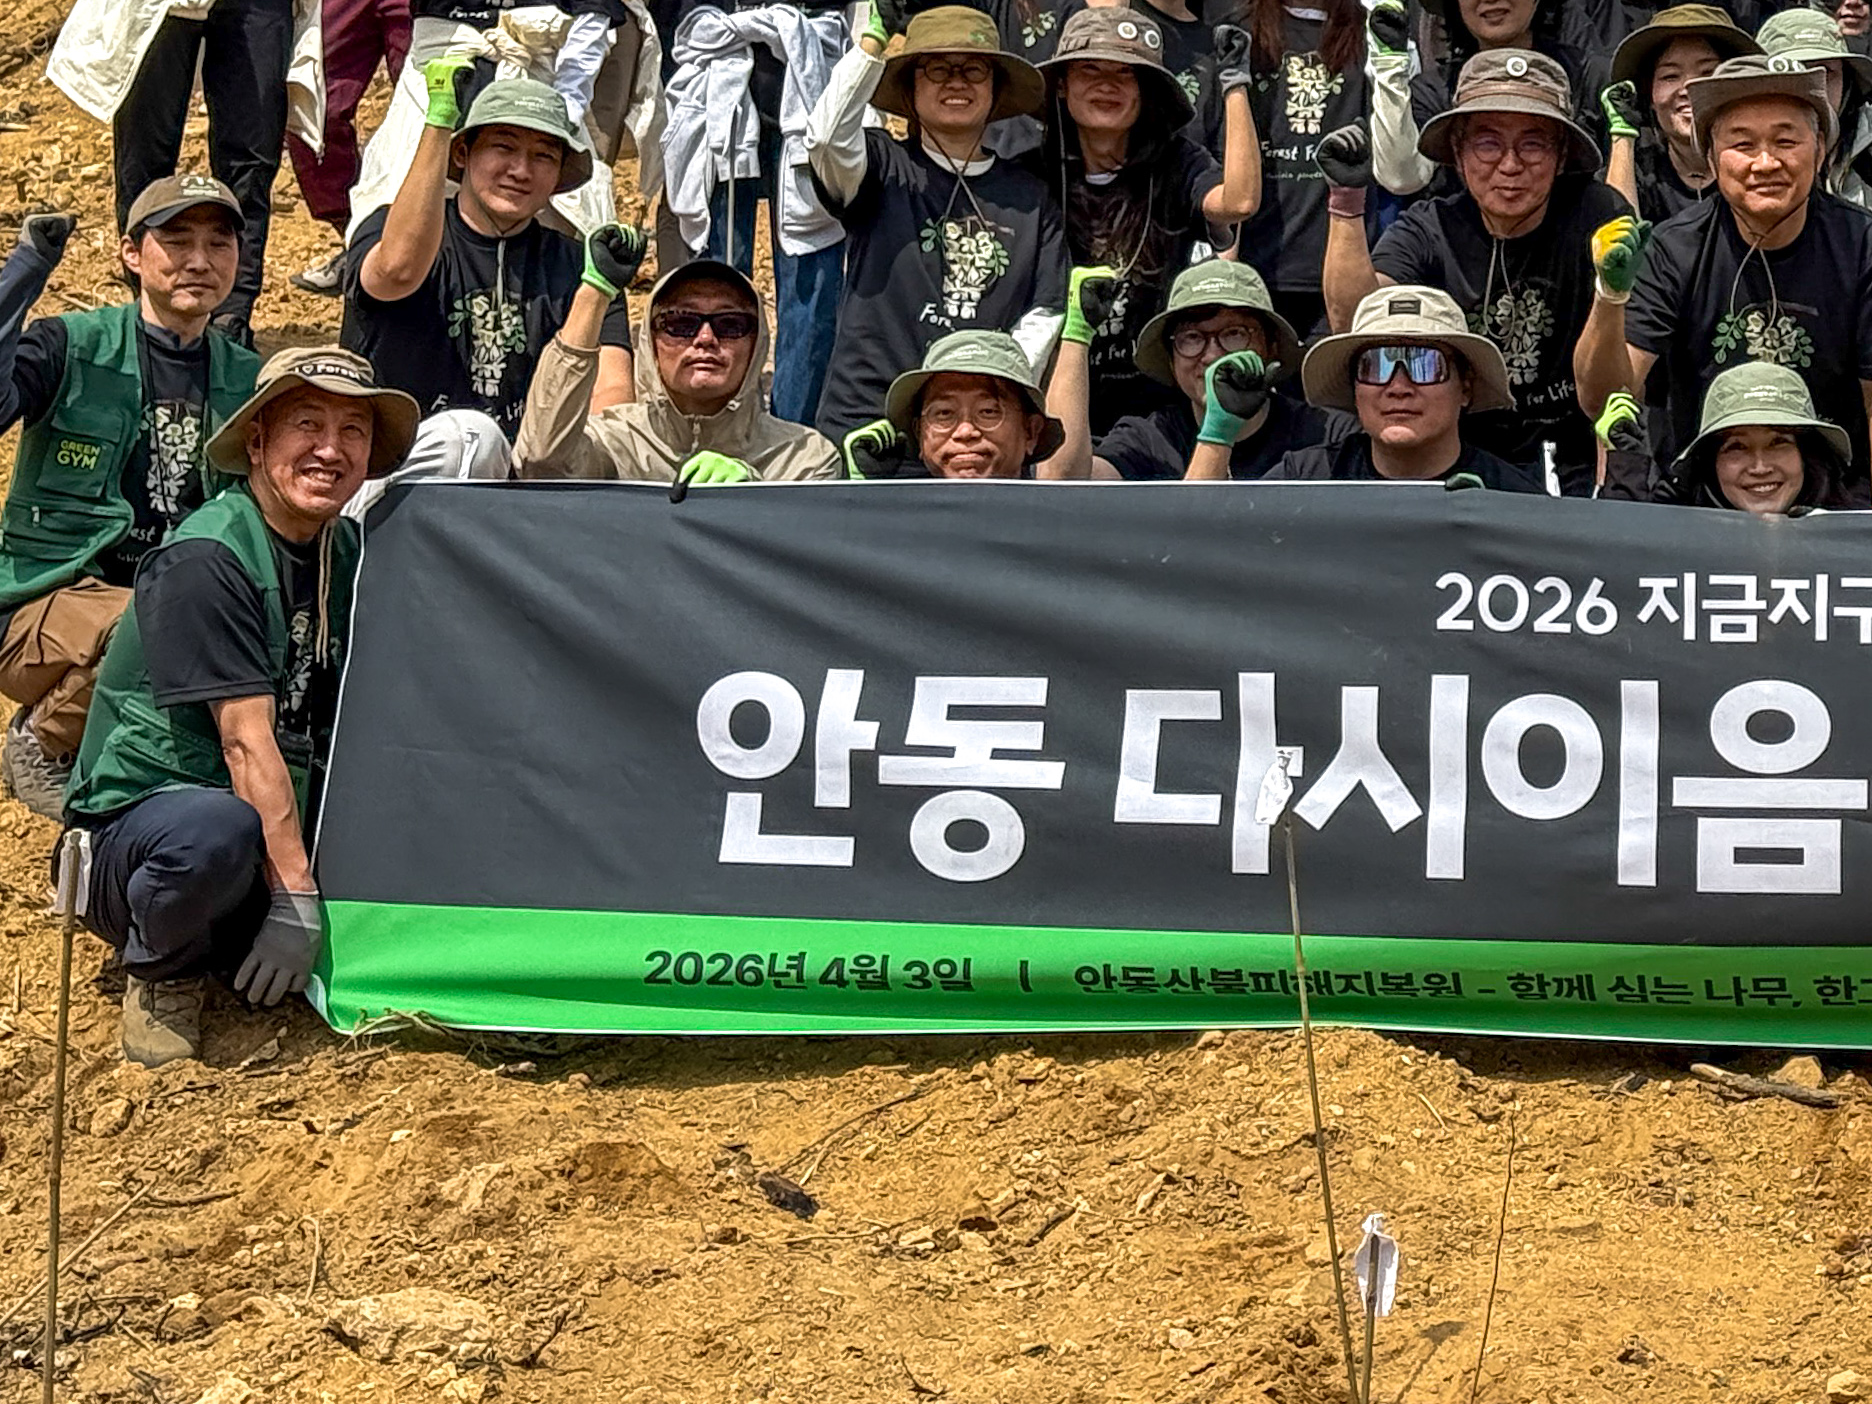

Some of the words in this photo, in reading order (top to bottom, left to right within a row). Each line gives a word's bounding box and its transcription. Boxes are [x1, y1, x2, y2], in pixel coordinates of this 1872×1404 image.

[57, 449, 98, 471] GYM
[60, 439, 101, 457] GREEN
[1435, 571, 1618, 635] 2026
[696, 668, 1067, 884] 안동
[643, 950, 808, 991] 2026년
[818, 953, 893, 992] 4월
[902, 956, 976, 993] 3일
[1074, 963, 1467, 999] 안동산불피해지복원
[1506, 972, 1597, 1002] 함께
[1607, 974, 1694, 1005] 심는
[1703, 975, 1803, 1008] 나무,
